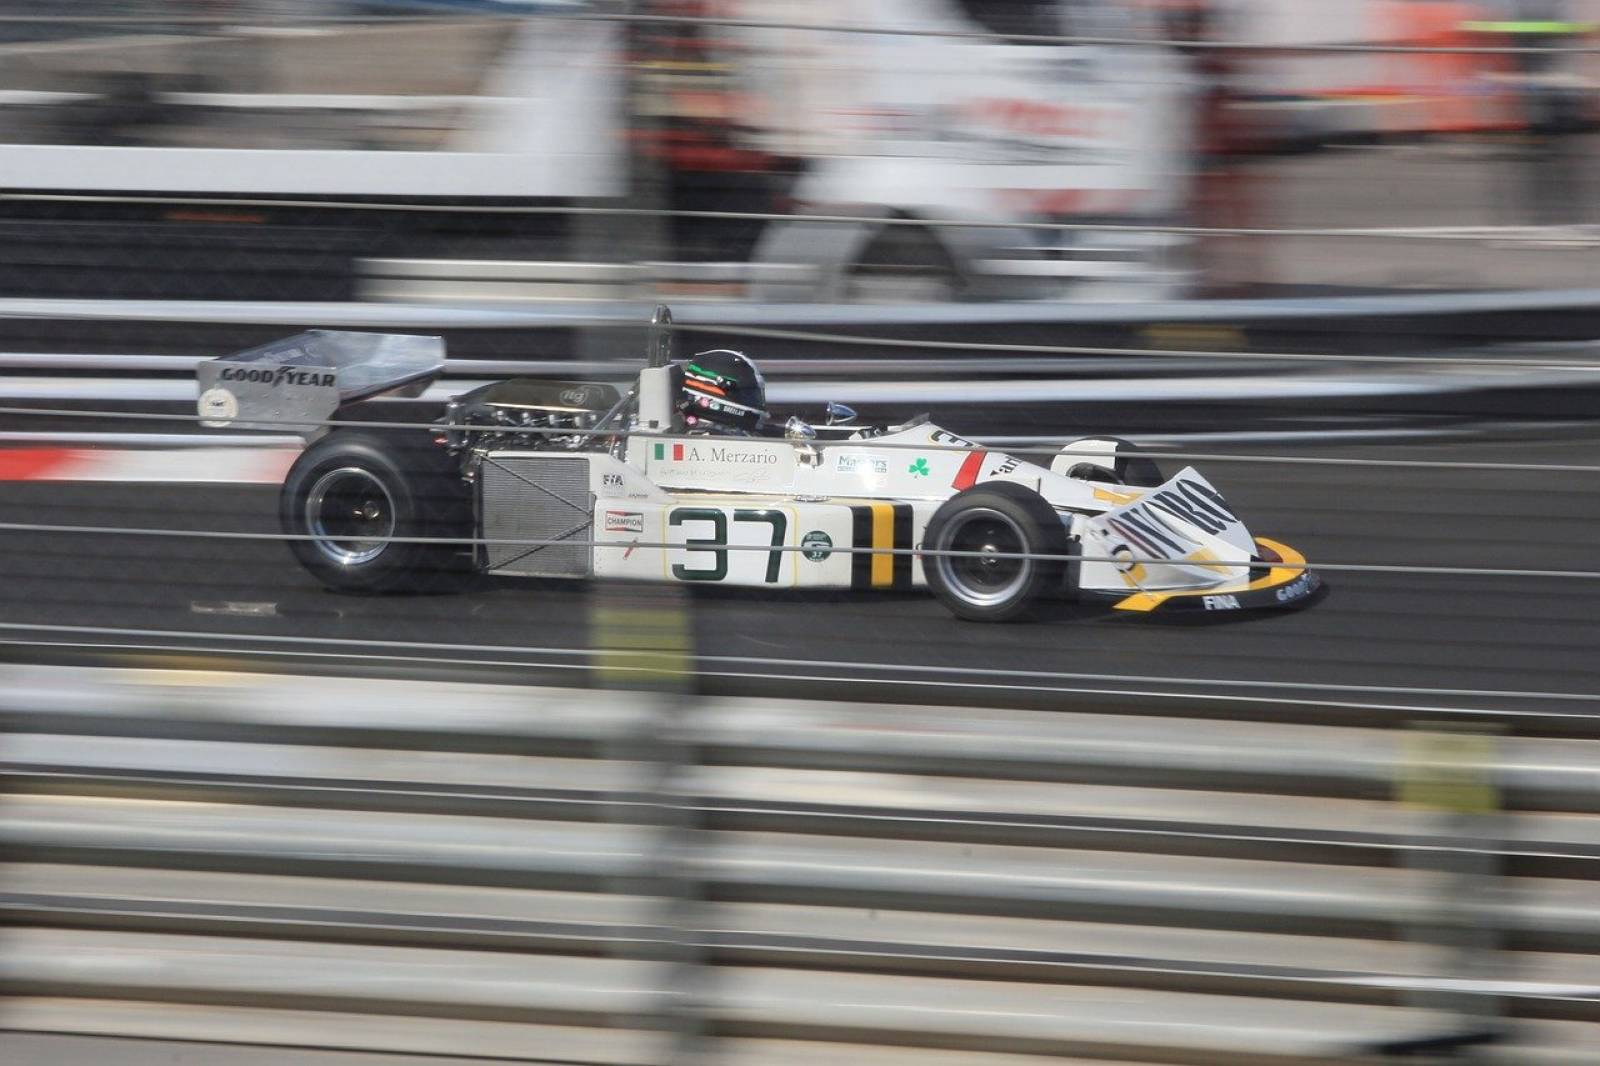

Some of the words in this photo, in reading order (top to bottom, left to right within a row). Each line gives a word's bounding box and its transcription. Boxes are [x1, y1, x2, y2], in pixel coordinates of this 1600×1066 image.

[221, 366, 336, 387] GOODYEAR
[688, 447, 704, 462] A.
[711, 447, 778, 465] Merzario
[607, 516, 643, 527] CHAMPION
[669, 507, 787, 583] 37
